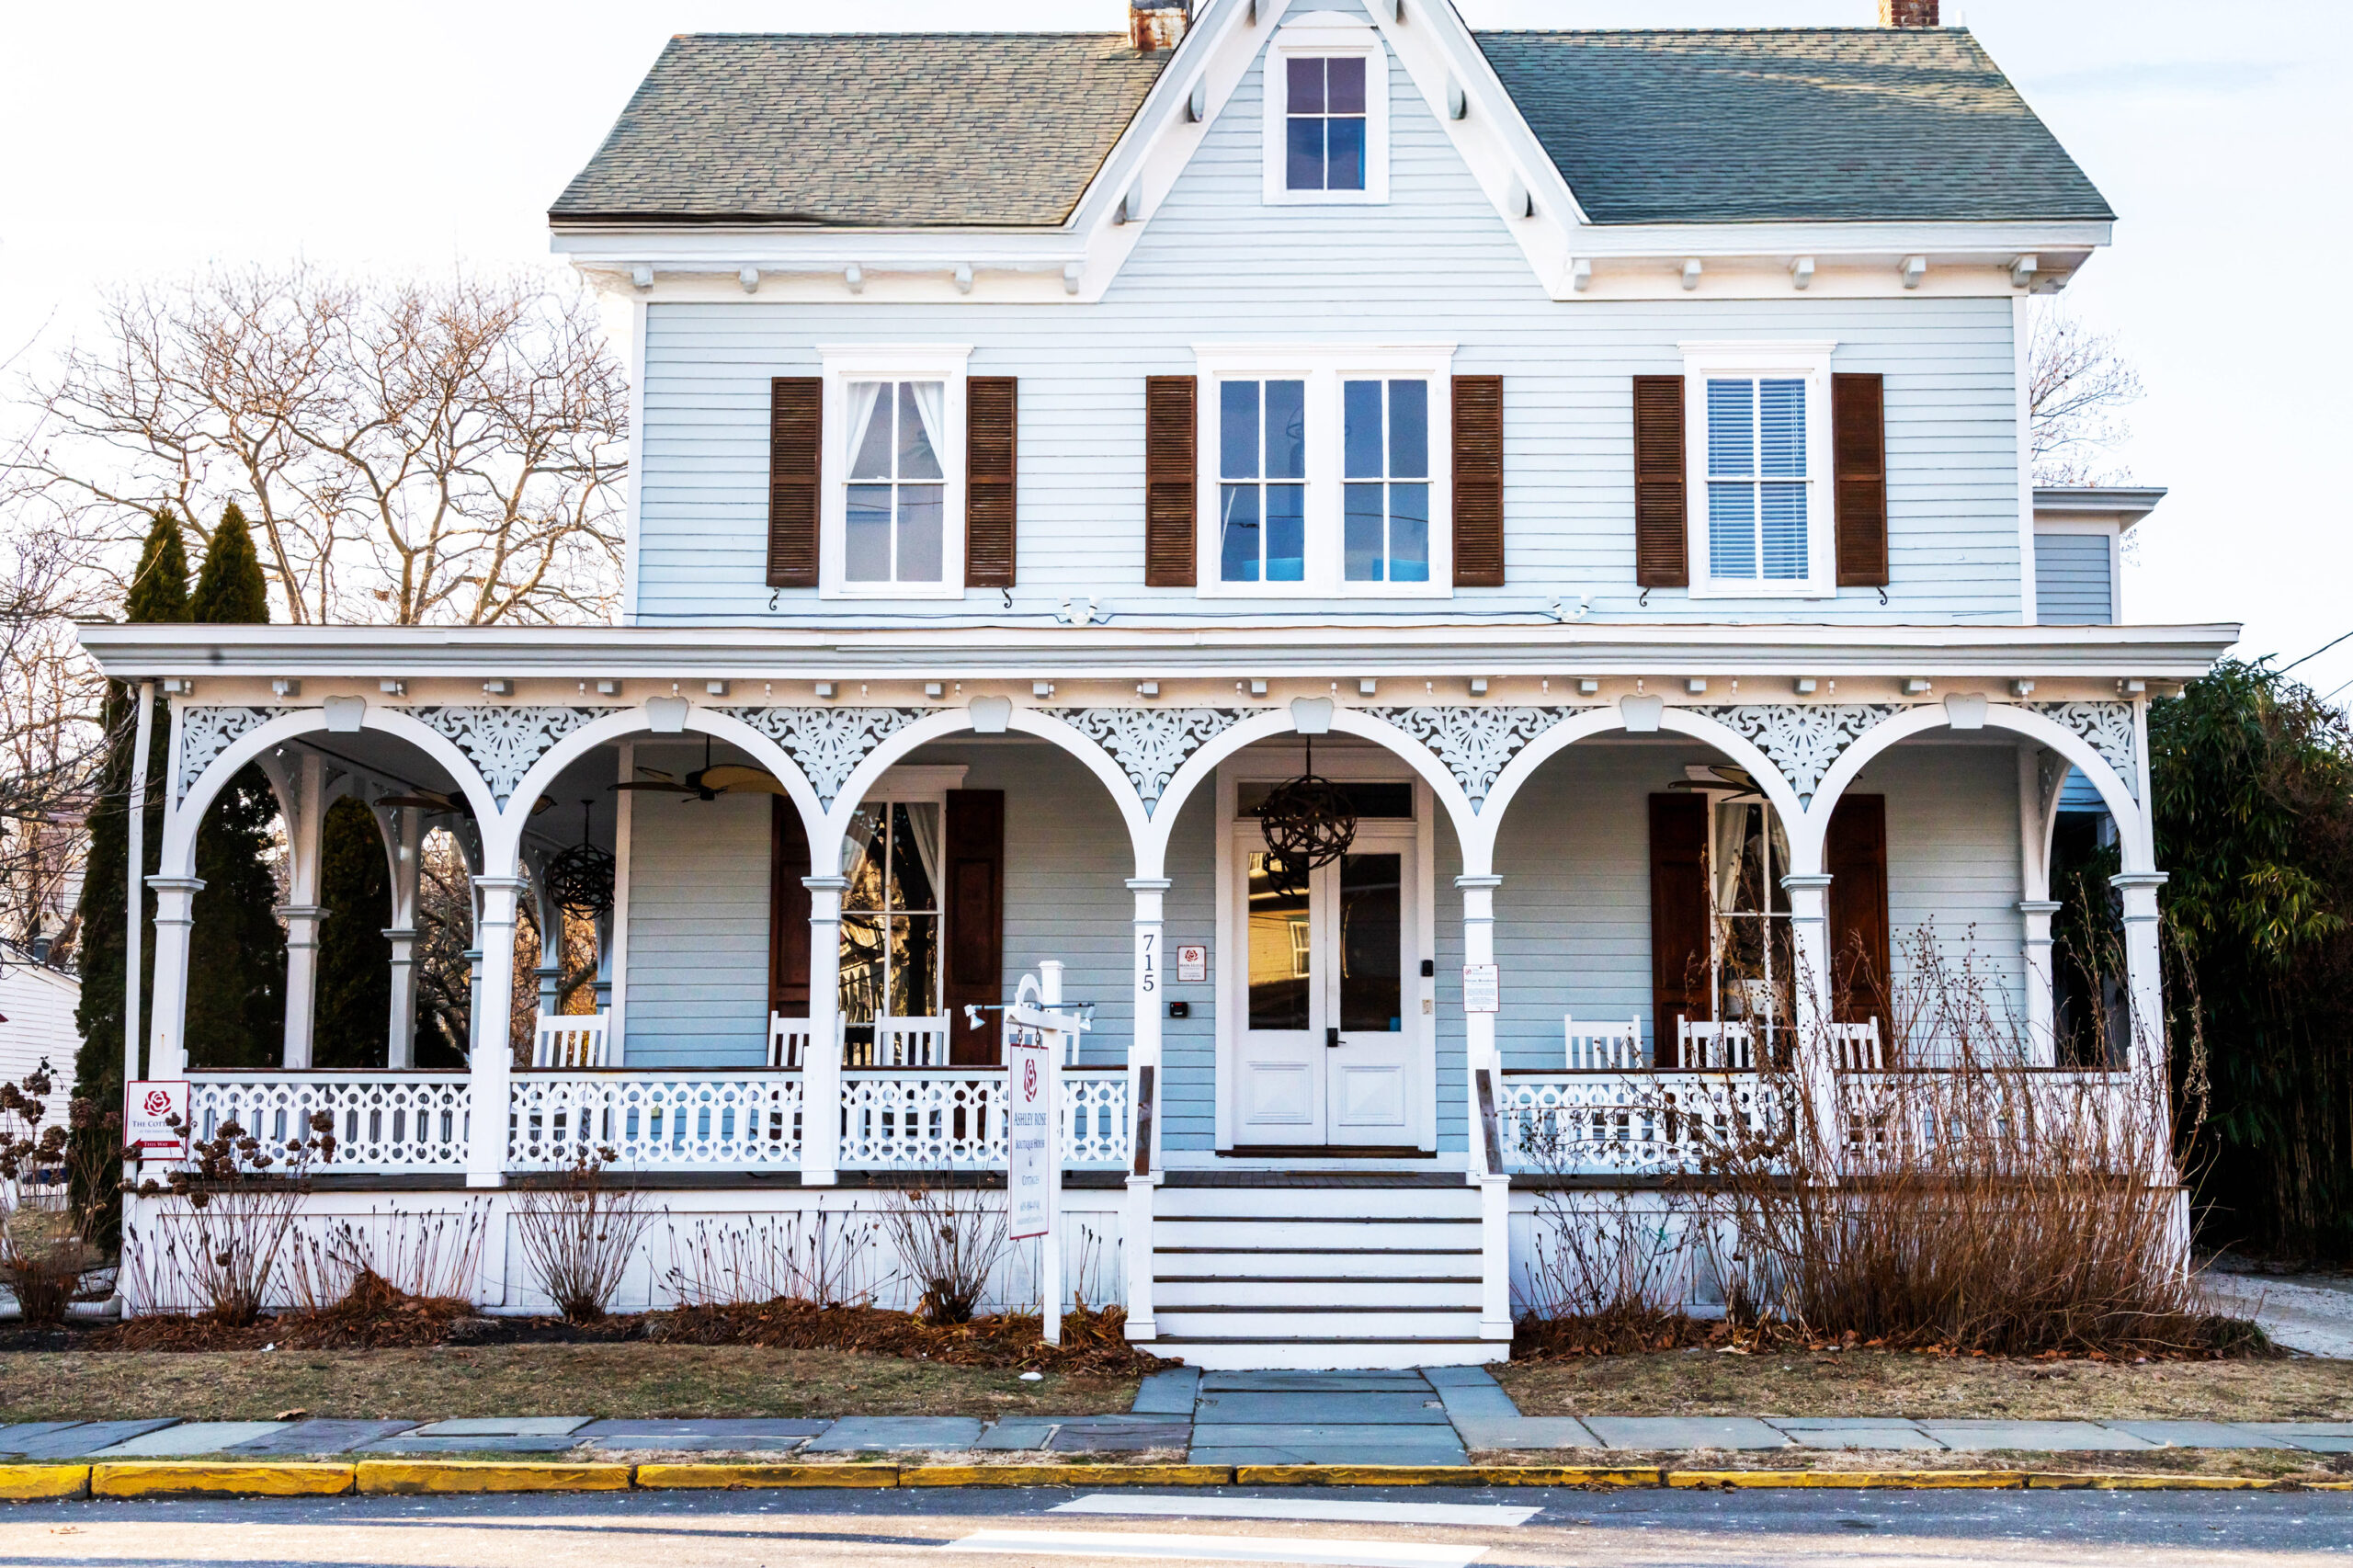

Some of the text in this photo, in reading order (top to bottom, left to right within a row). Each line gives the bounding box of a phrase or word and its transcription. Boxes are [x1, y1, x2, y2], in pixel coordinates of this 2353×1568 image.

[1142, 934, 1154, 992] 715
[1014, 1112, 1046, 1126] ASHLEY ROSE
